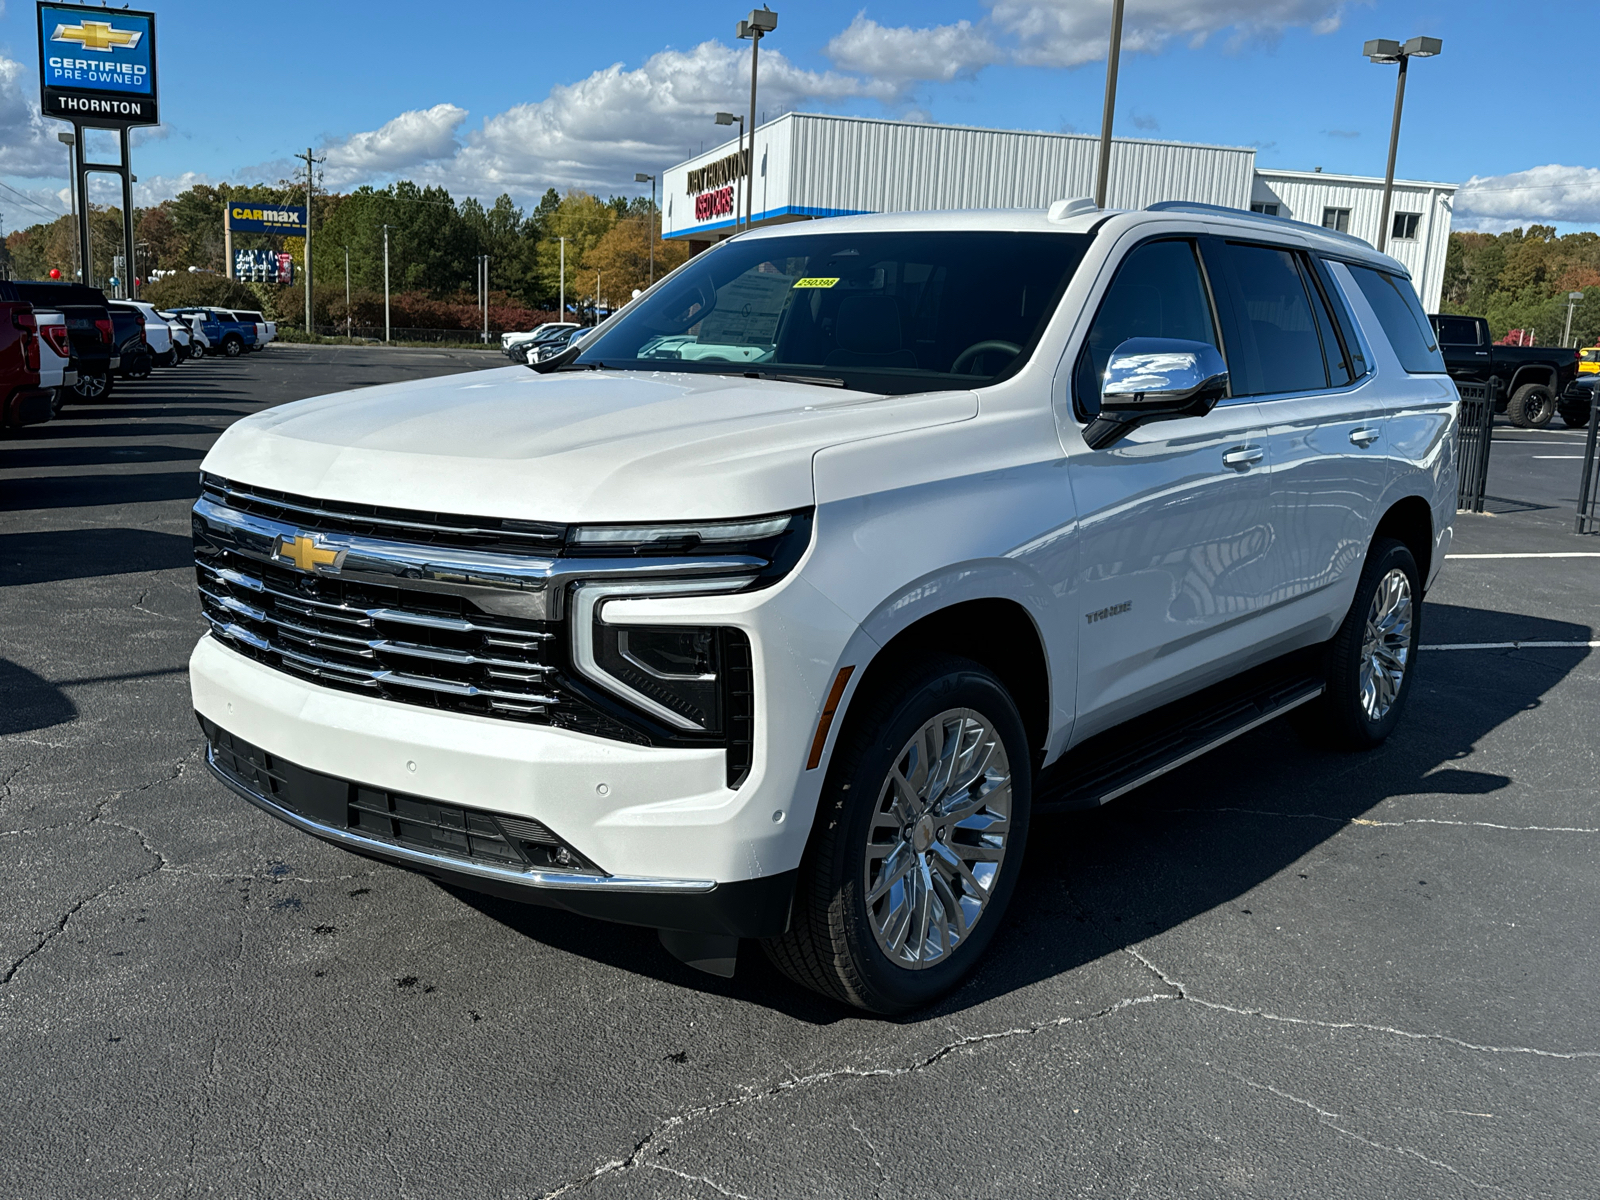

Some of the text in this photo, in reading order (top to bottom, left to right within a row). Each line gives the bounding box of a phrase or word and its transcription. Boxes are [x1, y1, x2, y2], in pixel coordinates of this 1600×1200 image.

[49, 57, 147, 75] CERTIFIED
[54, 68, 142, 85] PRE-OWNED
[58, 97, 141, 115] THORNTON
[686, 149, 749, 196] JOHN THORNTON
[695, 186, 735, 221] USED CARS
[1085, 600, 1133, 624] TAHOE
